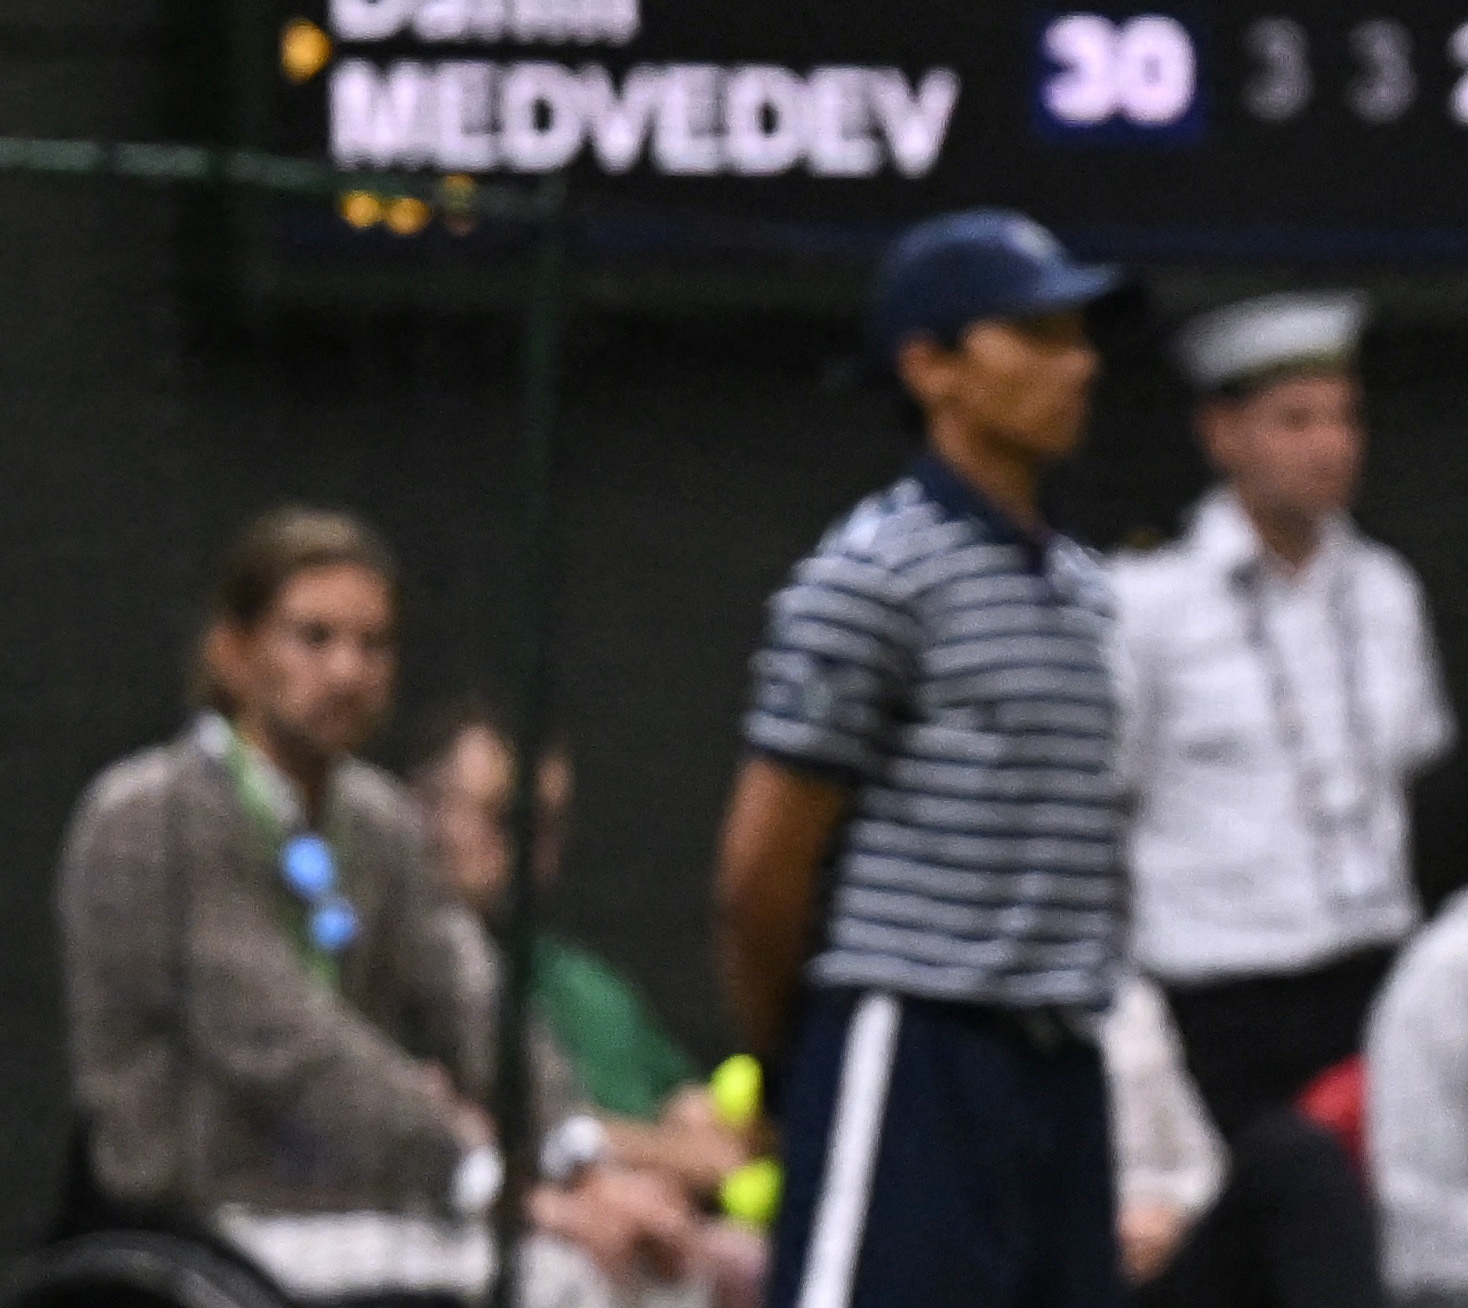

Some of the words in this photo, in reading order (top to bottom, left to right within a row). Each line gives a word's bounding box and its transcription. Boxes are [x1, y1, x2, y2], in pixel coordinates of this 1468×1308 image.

[330, 58, 958, 177] MEDVEDEV
[1044, 14, 1196, 126] 30
[1248, 16, 1313, 122] 3
[1350, 17, 1418, 122] 3
